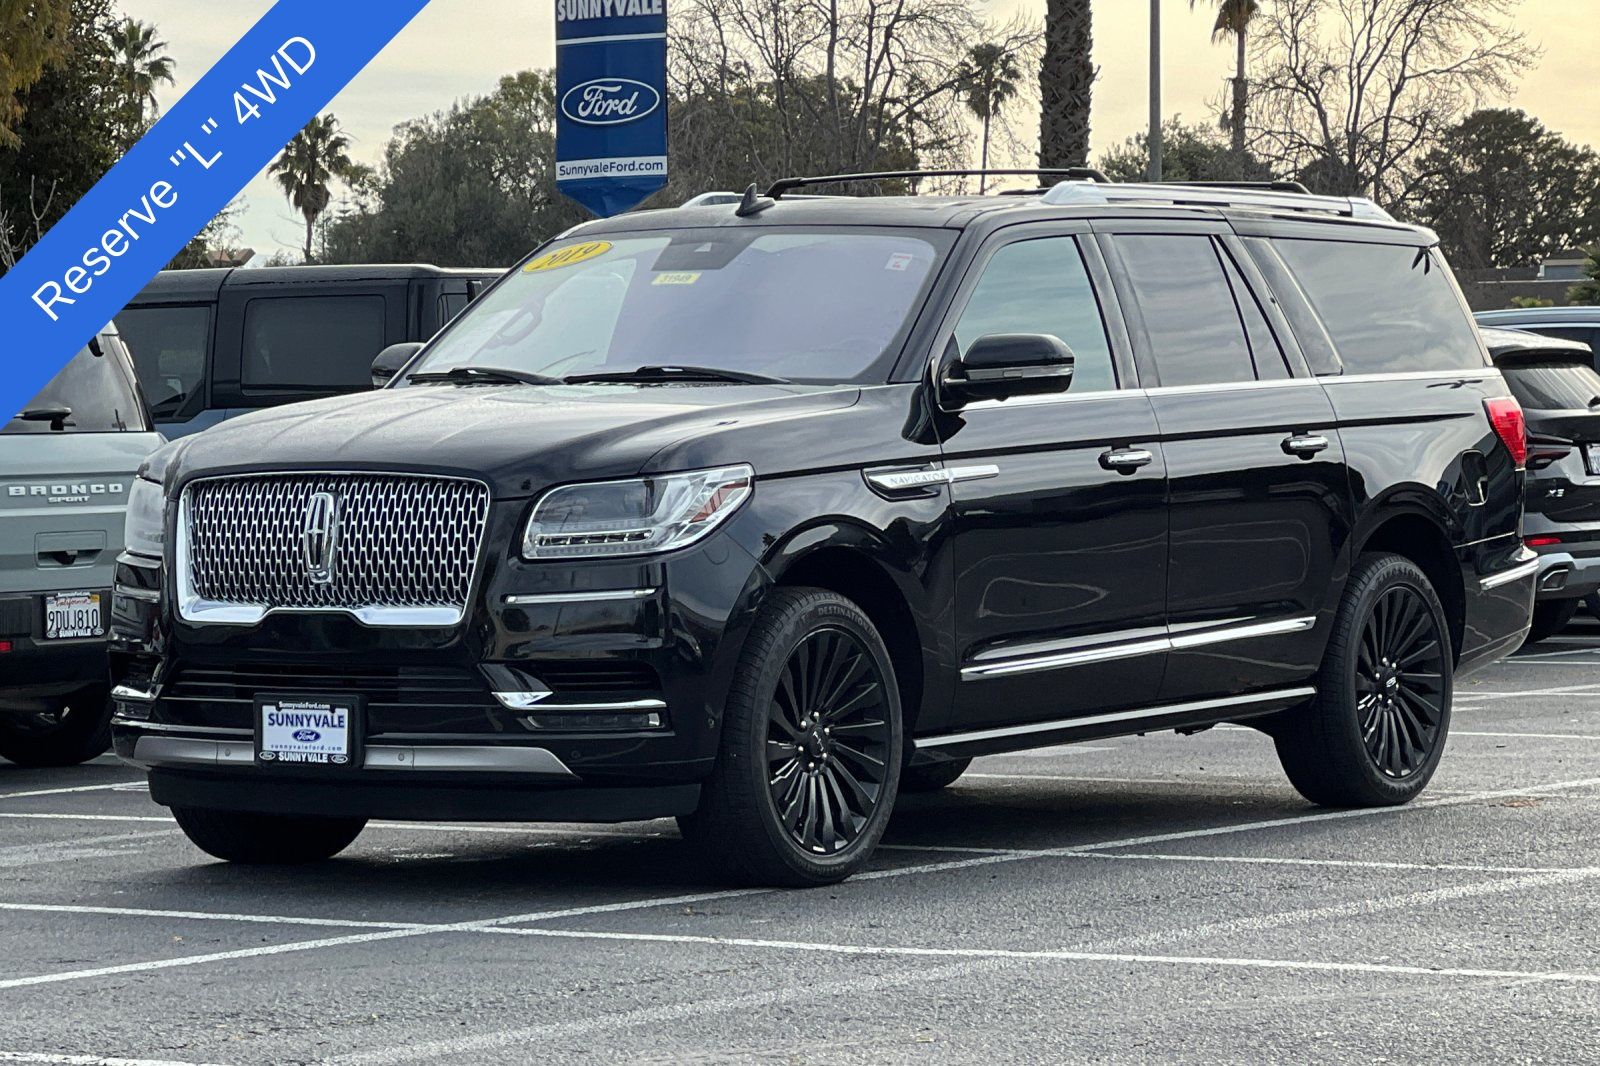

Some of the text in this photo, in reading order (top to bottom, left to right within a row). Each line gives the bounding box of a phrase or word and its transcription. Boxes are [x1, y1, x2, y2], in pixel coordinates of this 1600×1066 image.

[558, 0, 663, 22] SUNNYVALE
[578, 85, 639, 117] Ford
[559, 161, 663, 176] SunnyvaleFord.com
[889, 472, 946, 485] NAVIGATOR
[8, 483, 123, 496] BRONCO
[48, 495, 90, 503] SPORT
[48, 608, 99, 632] 9DUJ810
[59, 628, 91, 638] SUNNYVALE
[268, 713, 345, 728] SUNNYVALE
[279, 752, 328, 763] SUNNYVALE
